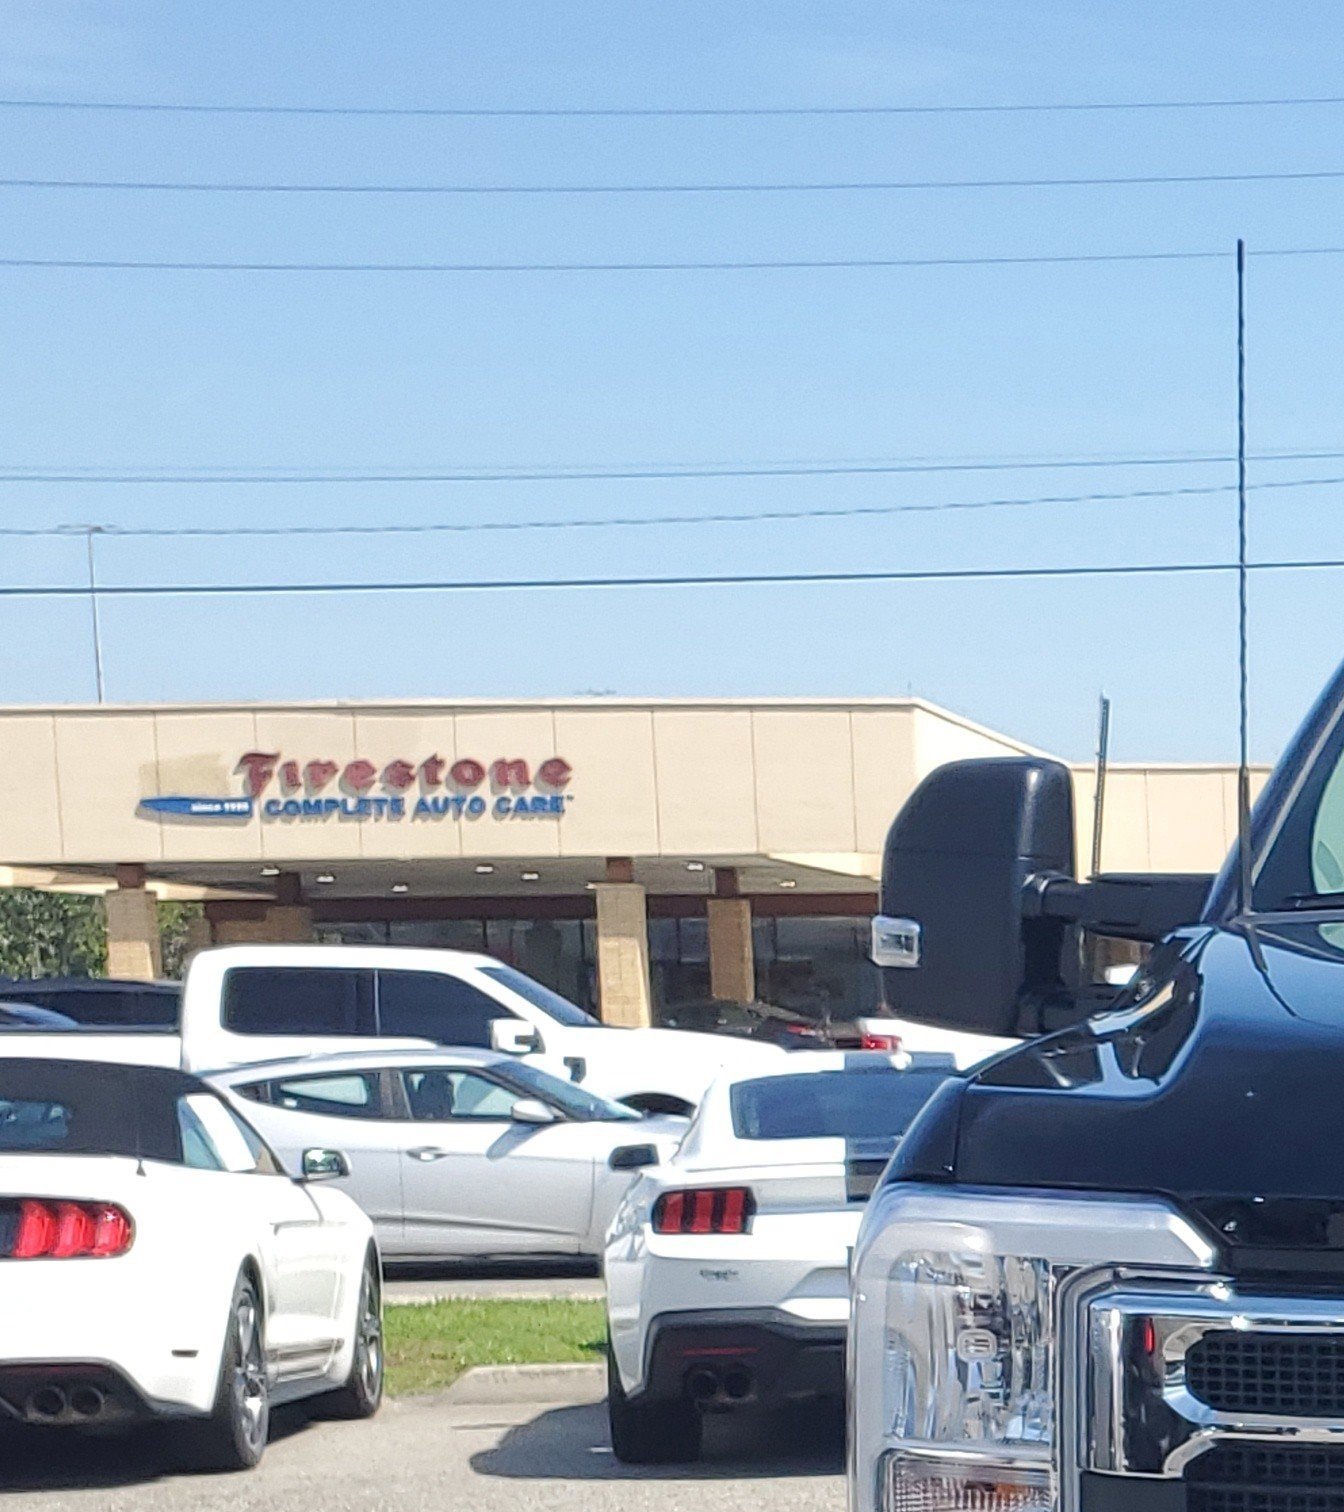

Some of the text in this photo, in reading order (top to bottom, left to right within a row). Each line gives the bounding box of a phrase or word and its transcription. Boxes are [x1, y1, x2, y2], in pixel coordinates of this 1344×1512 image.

[233, 753, 572, 797] Firestone
[264, 796, 565, 816] COMPLETE AUTO CARE
